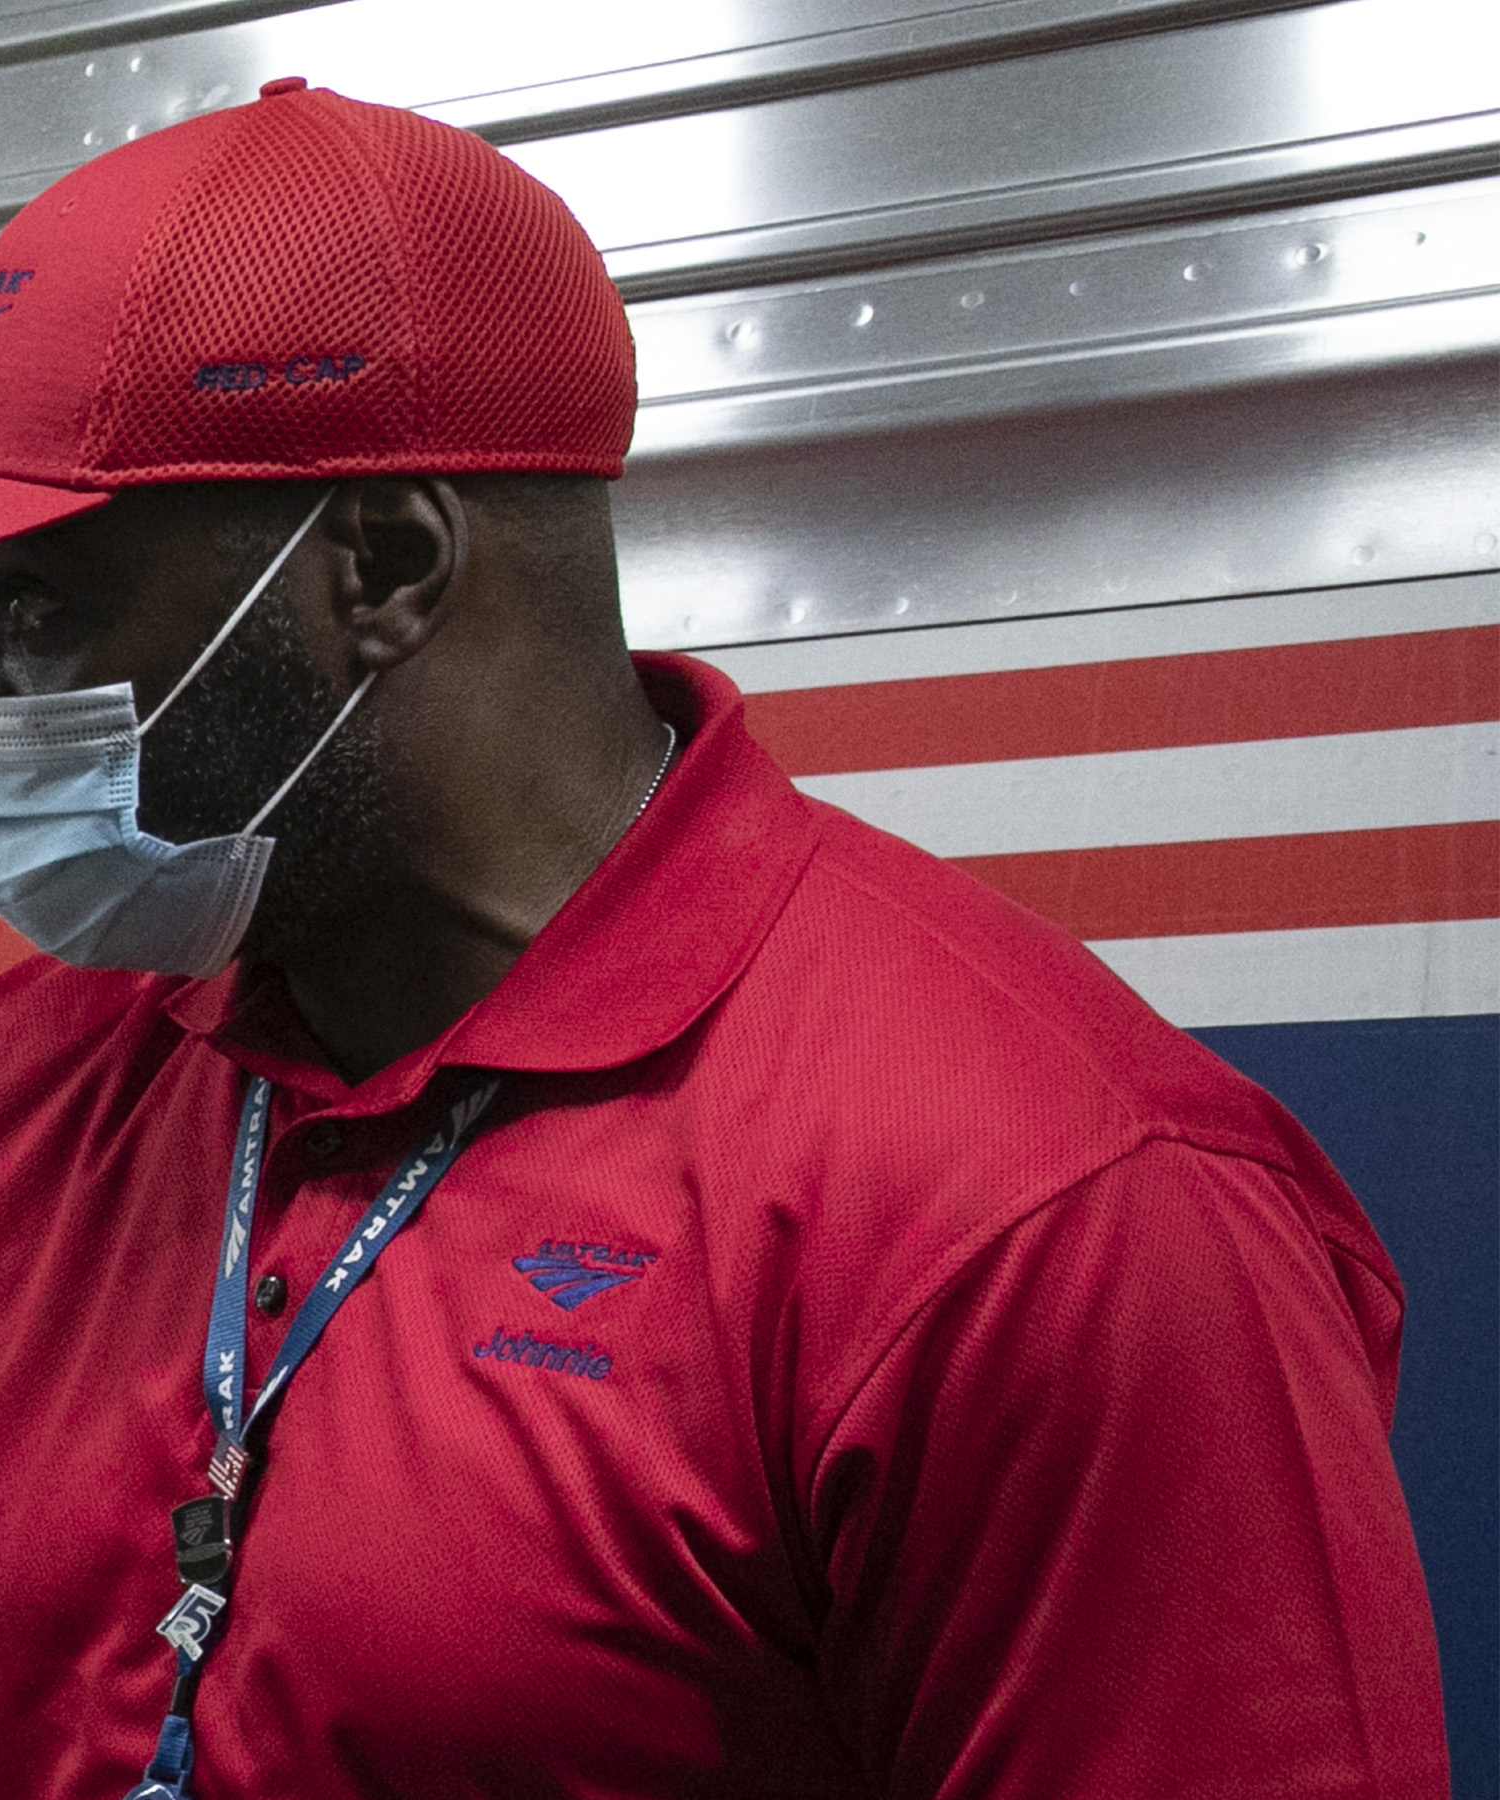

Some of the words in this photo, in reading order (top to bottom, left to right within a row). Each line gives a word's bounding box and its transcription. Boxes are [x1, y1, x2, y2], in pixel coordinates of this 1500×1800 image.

[195, 363, 267, 392] RED
[285, 354, 366, 385] CAP
[238, 1077, 265, 1214] AMTRA
[325, 1132, 444, 1293] AMTRAK
[218, 1349, 235, 1431] RAK
[472, 1325, 613, 1381] Johnnie
